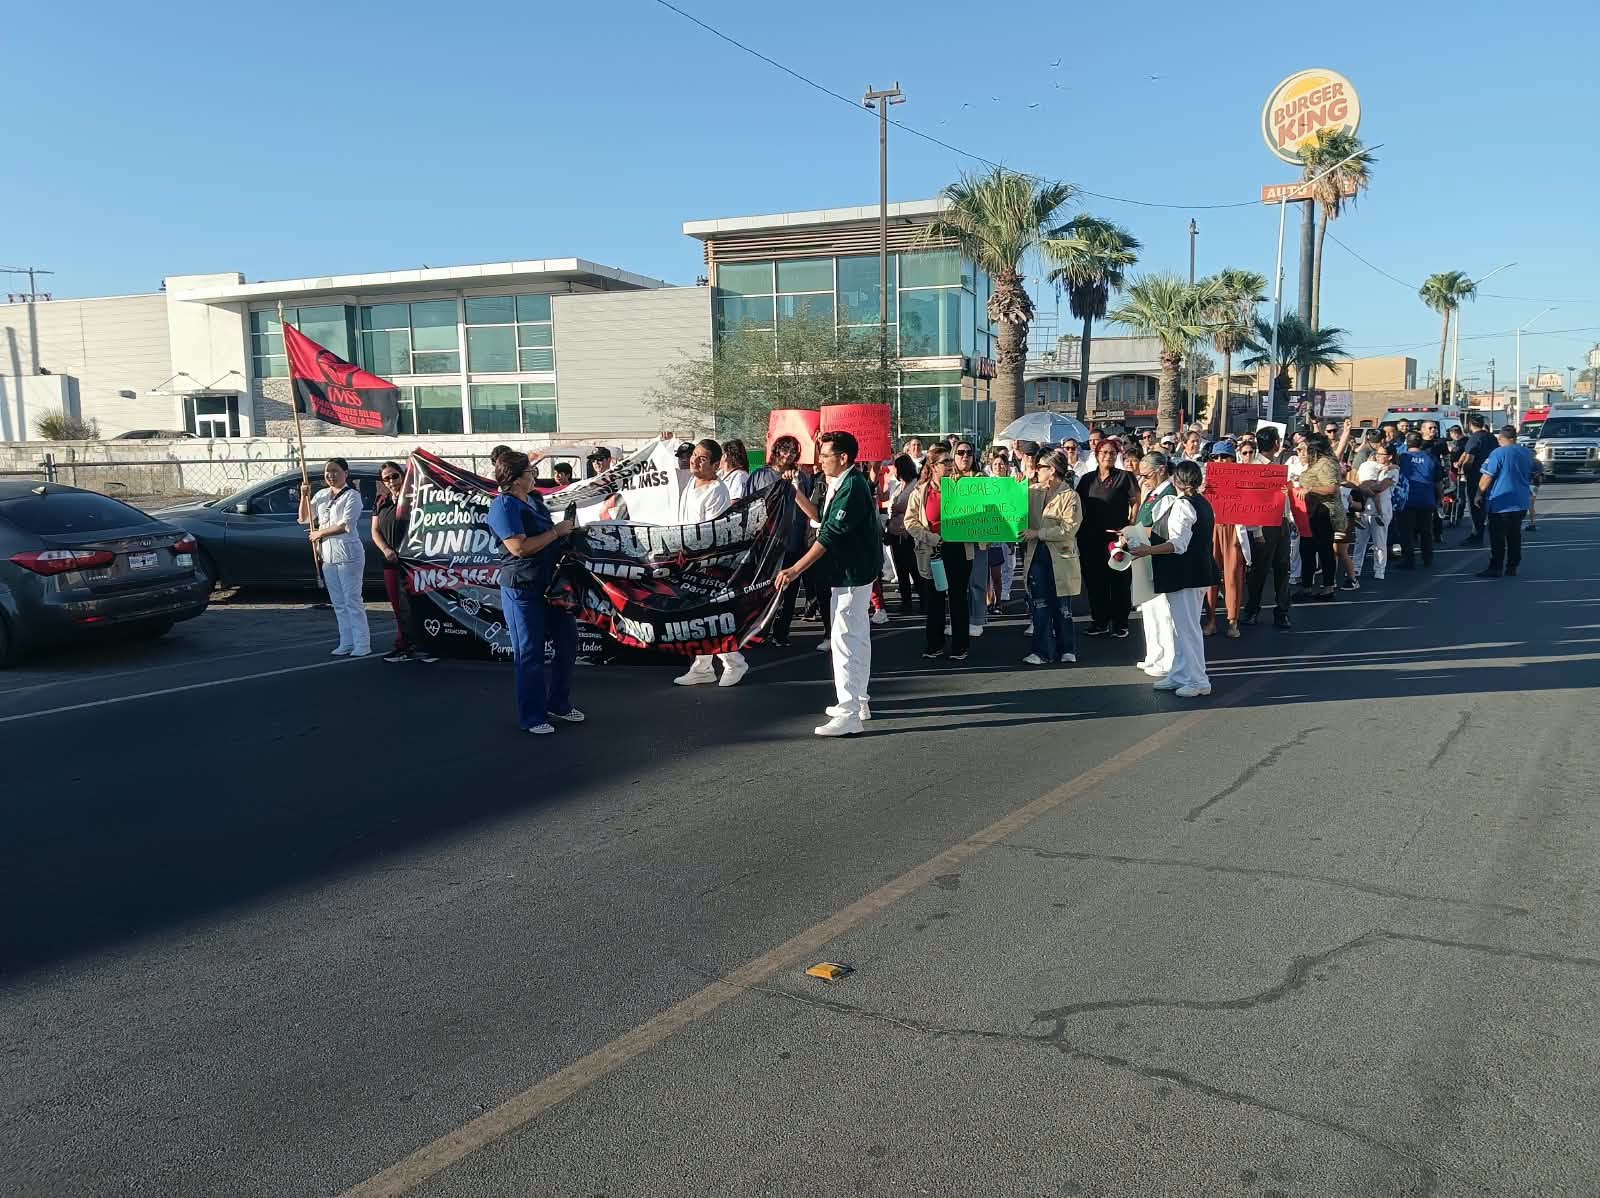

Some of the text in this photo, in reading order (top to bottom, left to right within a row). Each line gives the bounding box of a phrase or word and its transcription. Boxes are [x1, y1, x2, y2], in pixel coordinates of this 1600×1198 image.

[1274, 82, 1344, 126] BURGER
[1278, 98, 1348, 148] KING
[1267, 184, 1308, 199] AUTO
[639, 470, 669, 489] IMSS
[947, 481, 1001, 497] MEJORES
[449, 555, 471, 569] por
[414, 569, 459, 592] IMSS
[682, 573, 697, 581] un
[680, 582, 708, 594] para
[661, 612, 736, 642] JUSTO
[582, 641, 603, 652] todos
